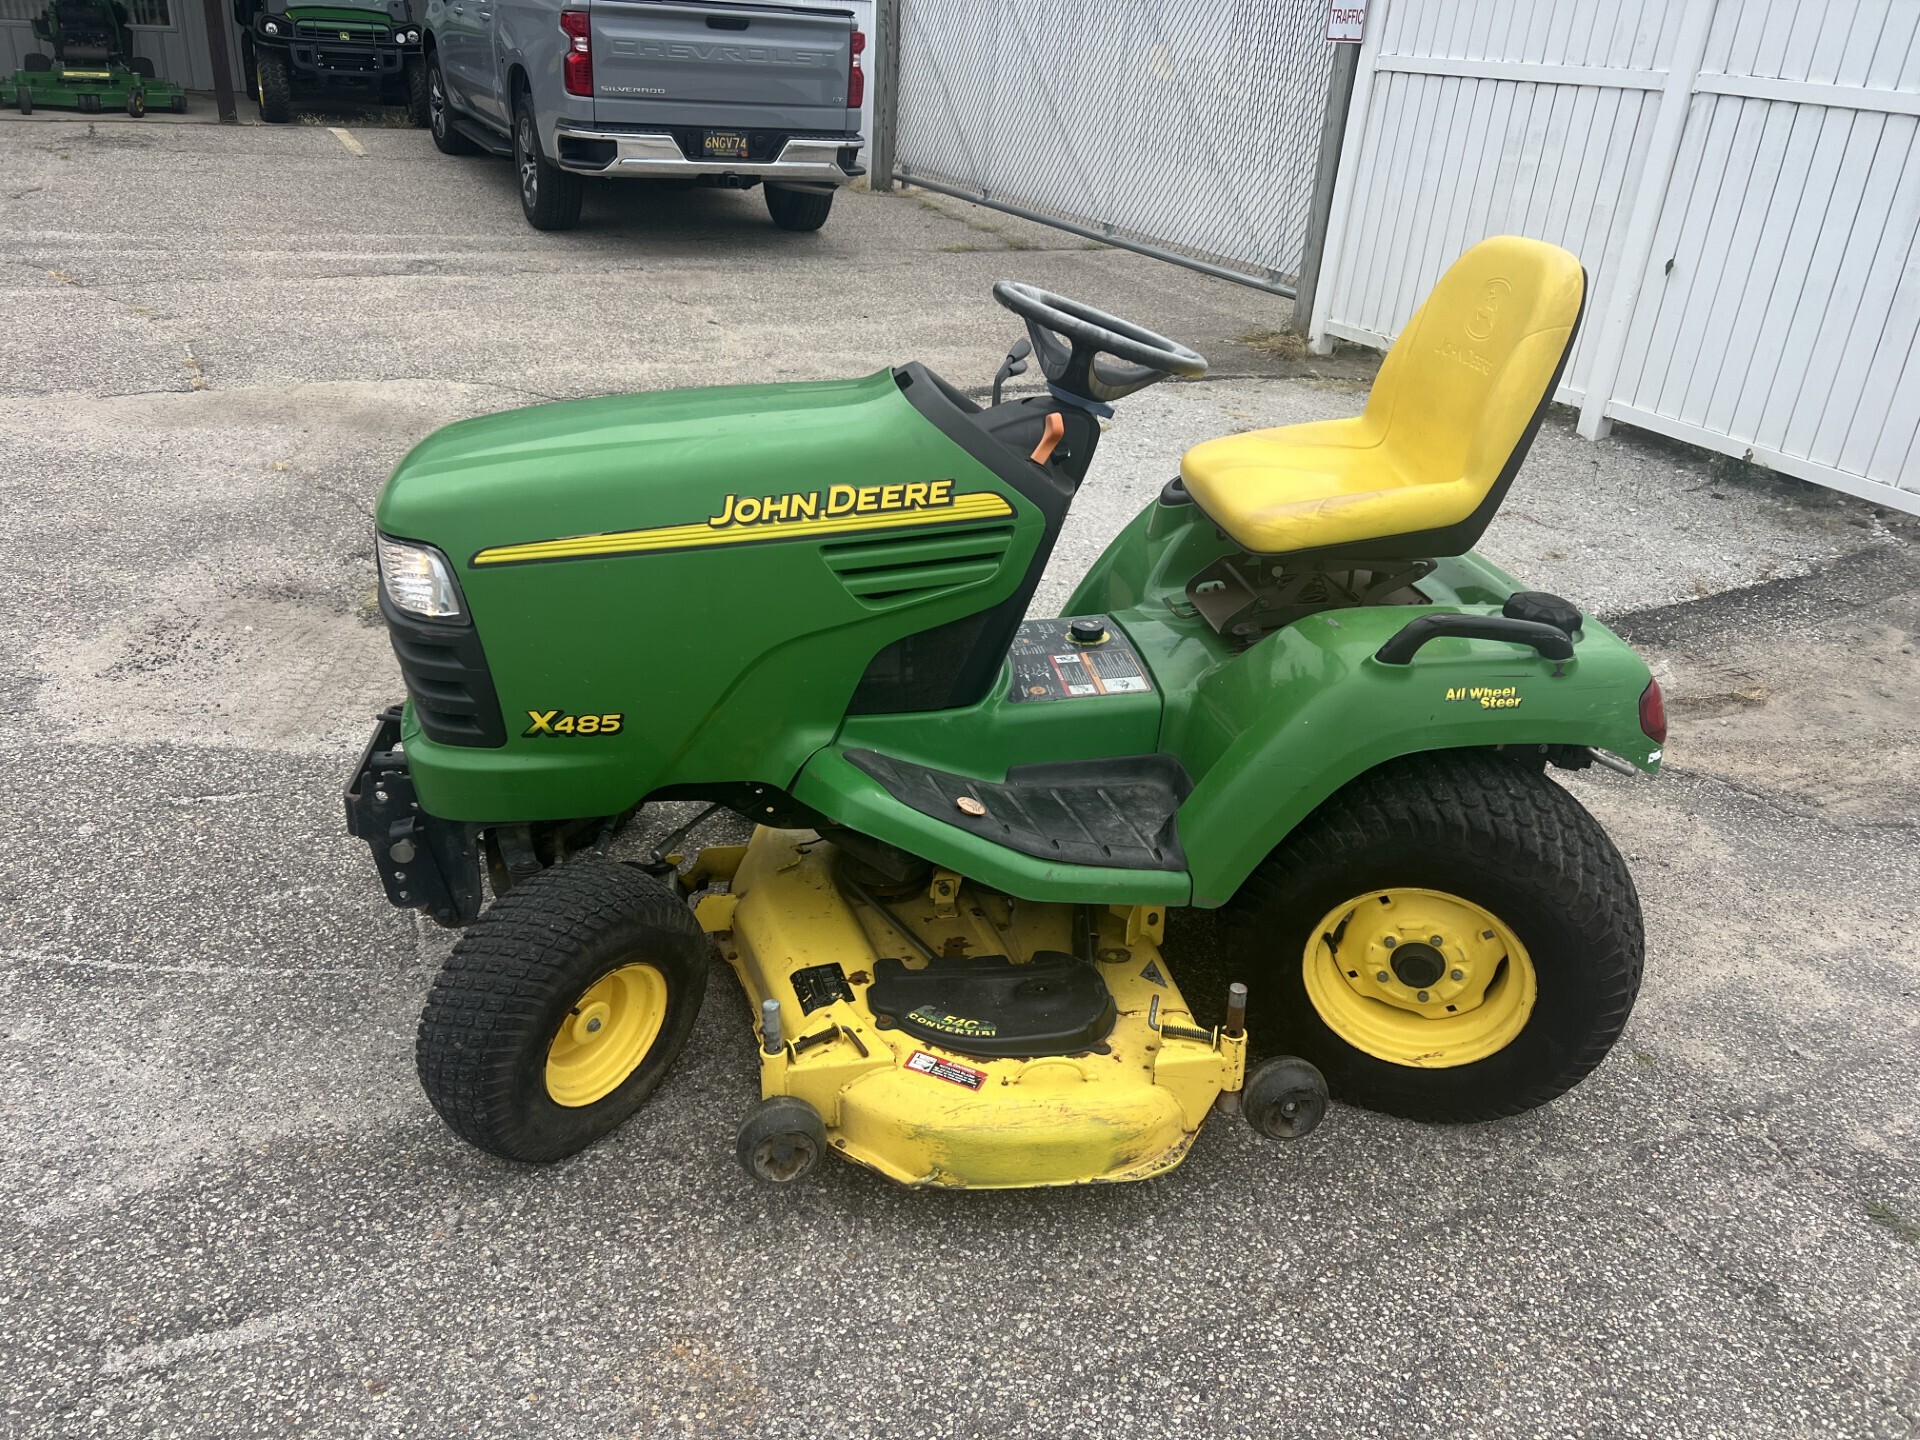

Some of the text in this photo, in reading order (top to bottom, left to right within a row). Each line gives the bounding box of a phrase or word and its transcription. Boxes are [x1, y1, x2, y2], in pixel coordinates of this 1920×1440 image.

[1331, 8, 1364, 25] TRAFFIC
[612, 40, 835, 66] CHEVROLET
[600, 85, 666, 94] SILVERADO
[705, 136, 747, 149] 6NGV74
[709, 479, 955, 526] JOHN DEERE
[1445, 686, 1516, 701] All Wheel
[1480, 696, 1522, 709] Steer
[523, 710, 624, 737] X485
[940, 1015, 980, 1030] 54C
